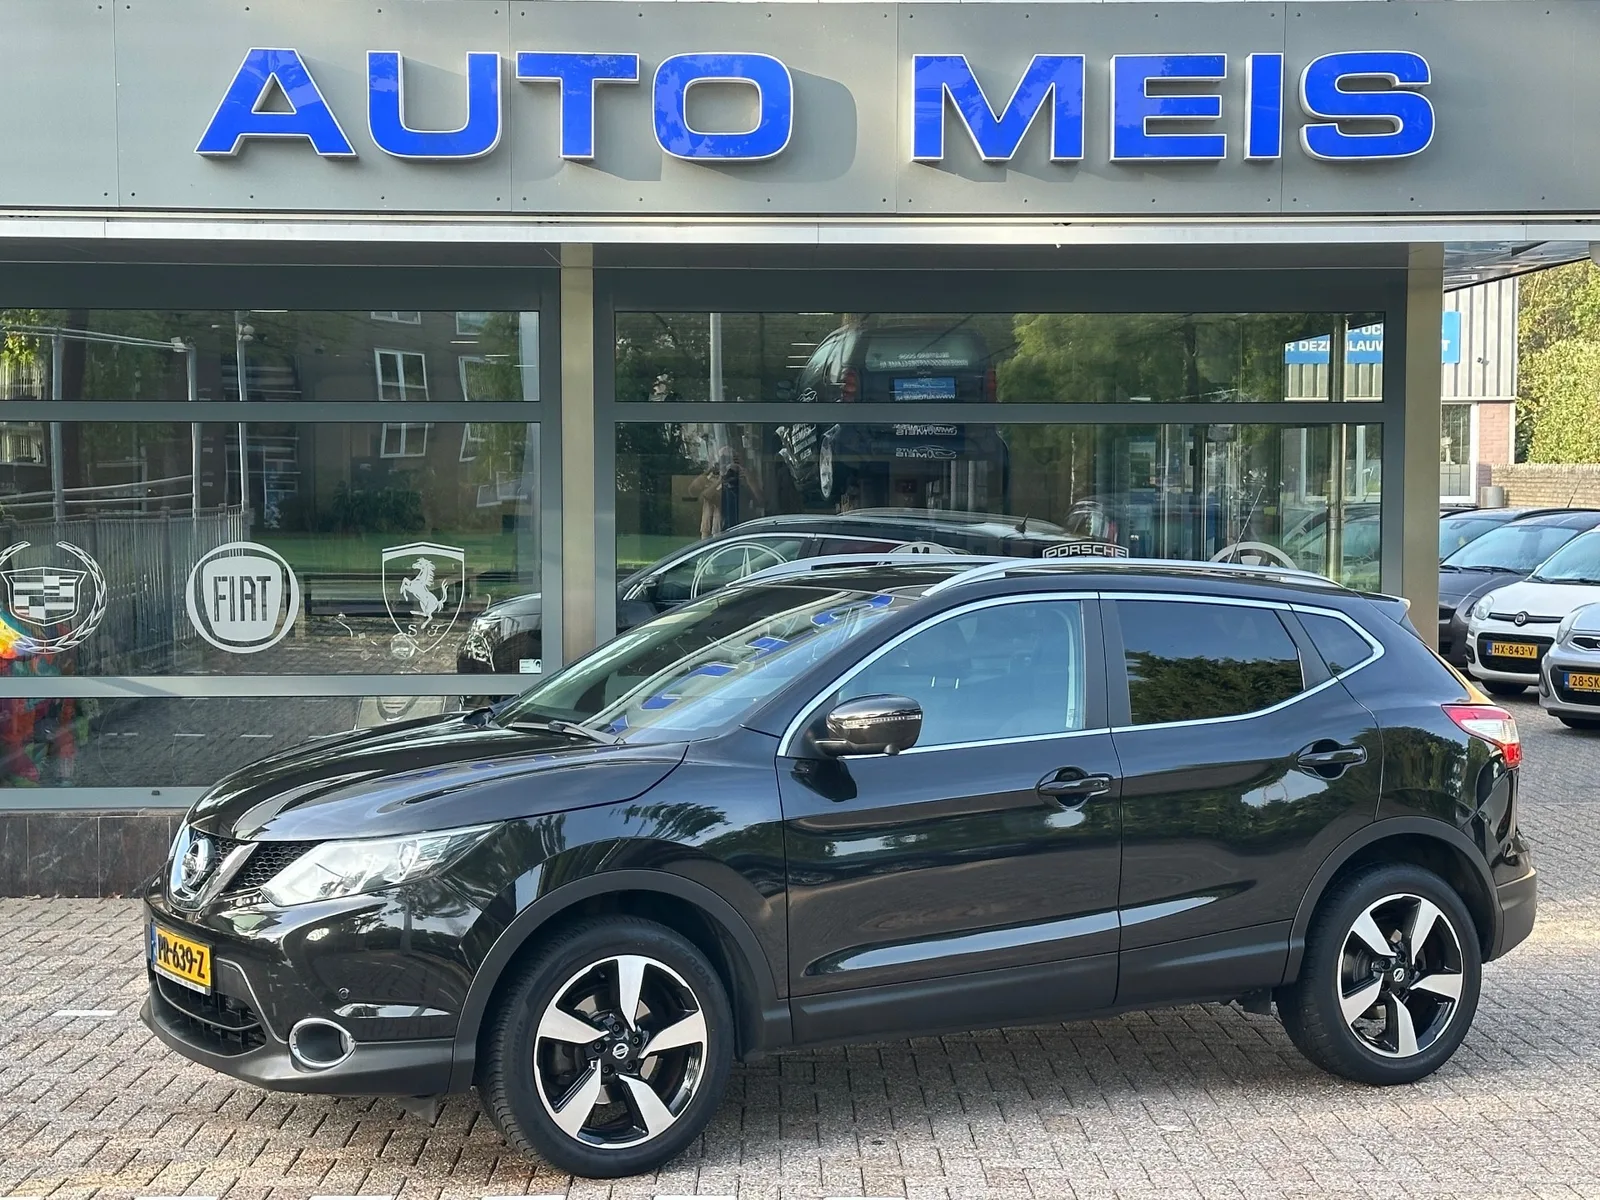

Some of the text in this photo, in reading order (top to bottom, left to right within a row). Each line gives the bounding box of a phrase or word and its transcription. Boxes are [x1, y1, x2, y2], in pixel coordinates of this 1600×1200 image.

[194, 47, 1436, 163] AUTO MEIS
[1046, 544, 1126, 558] PORSCHE
[213, 576, 272, 622] FIAT
[1493, 644, 1534, 657] HX-843-V
[157, 933, 206, 980] PR-639-Z
